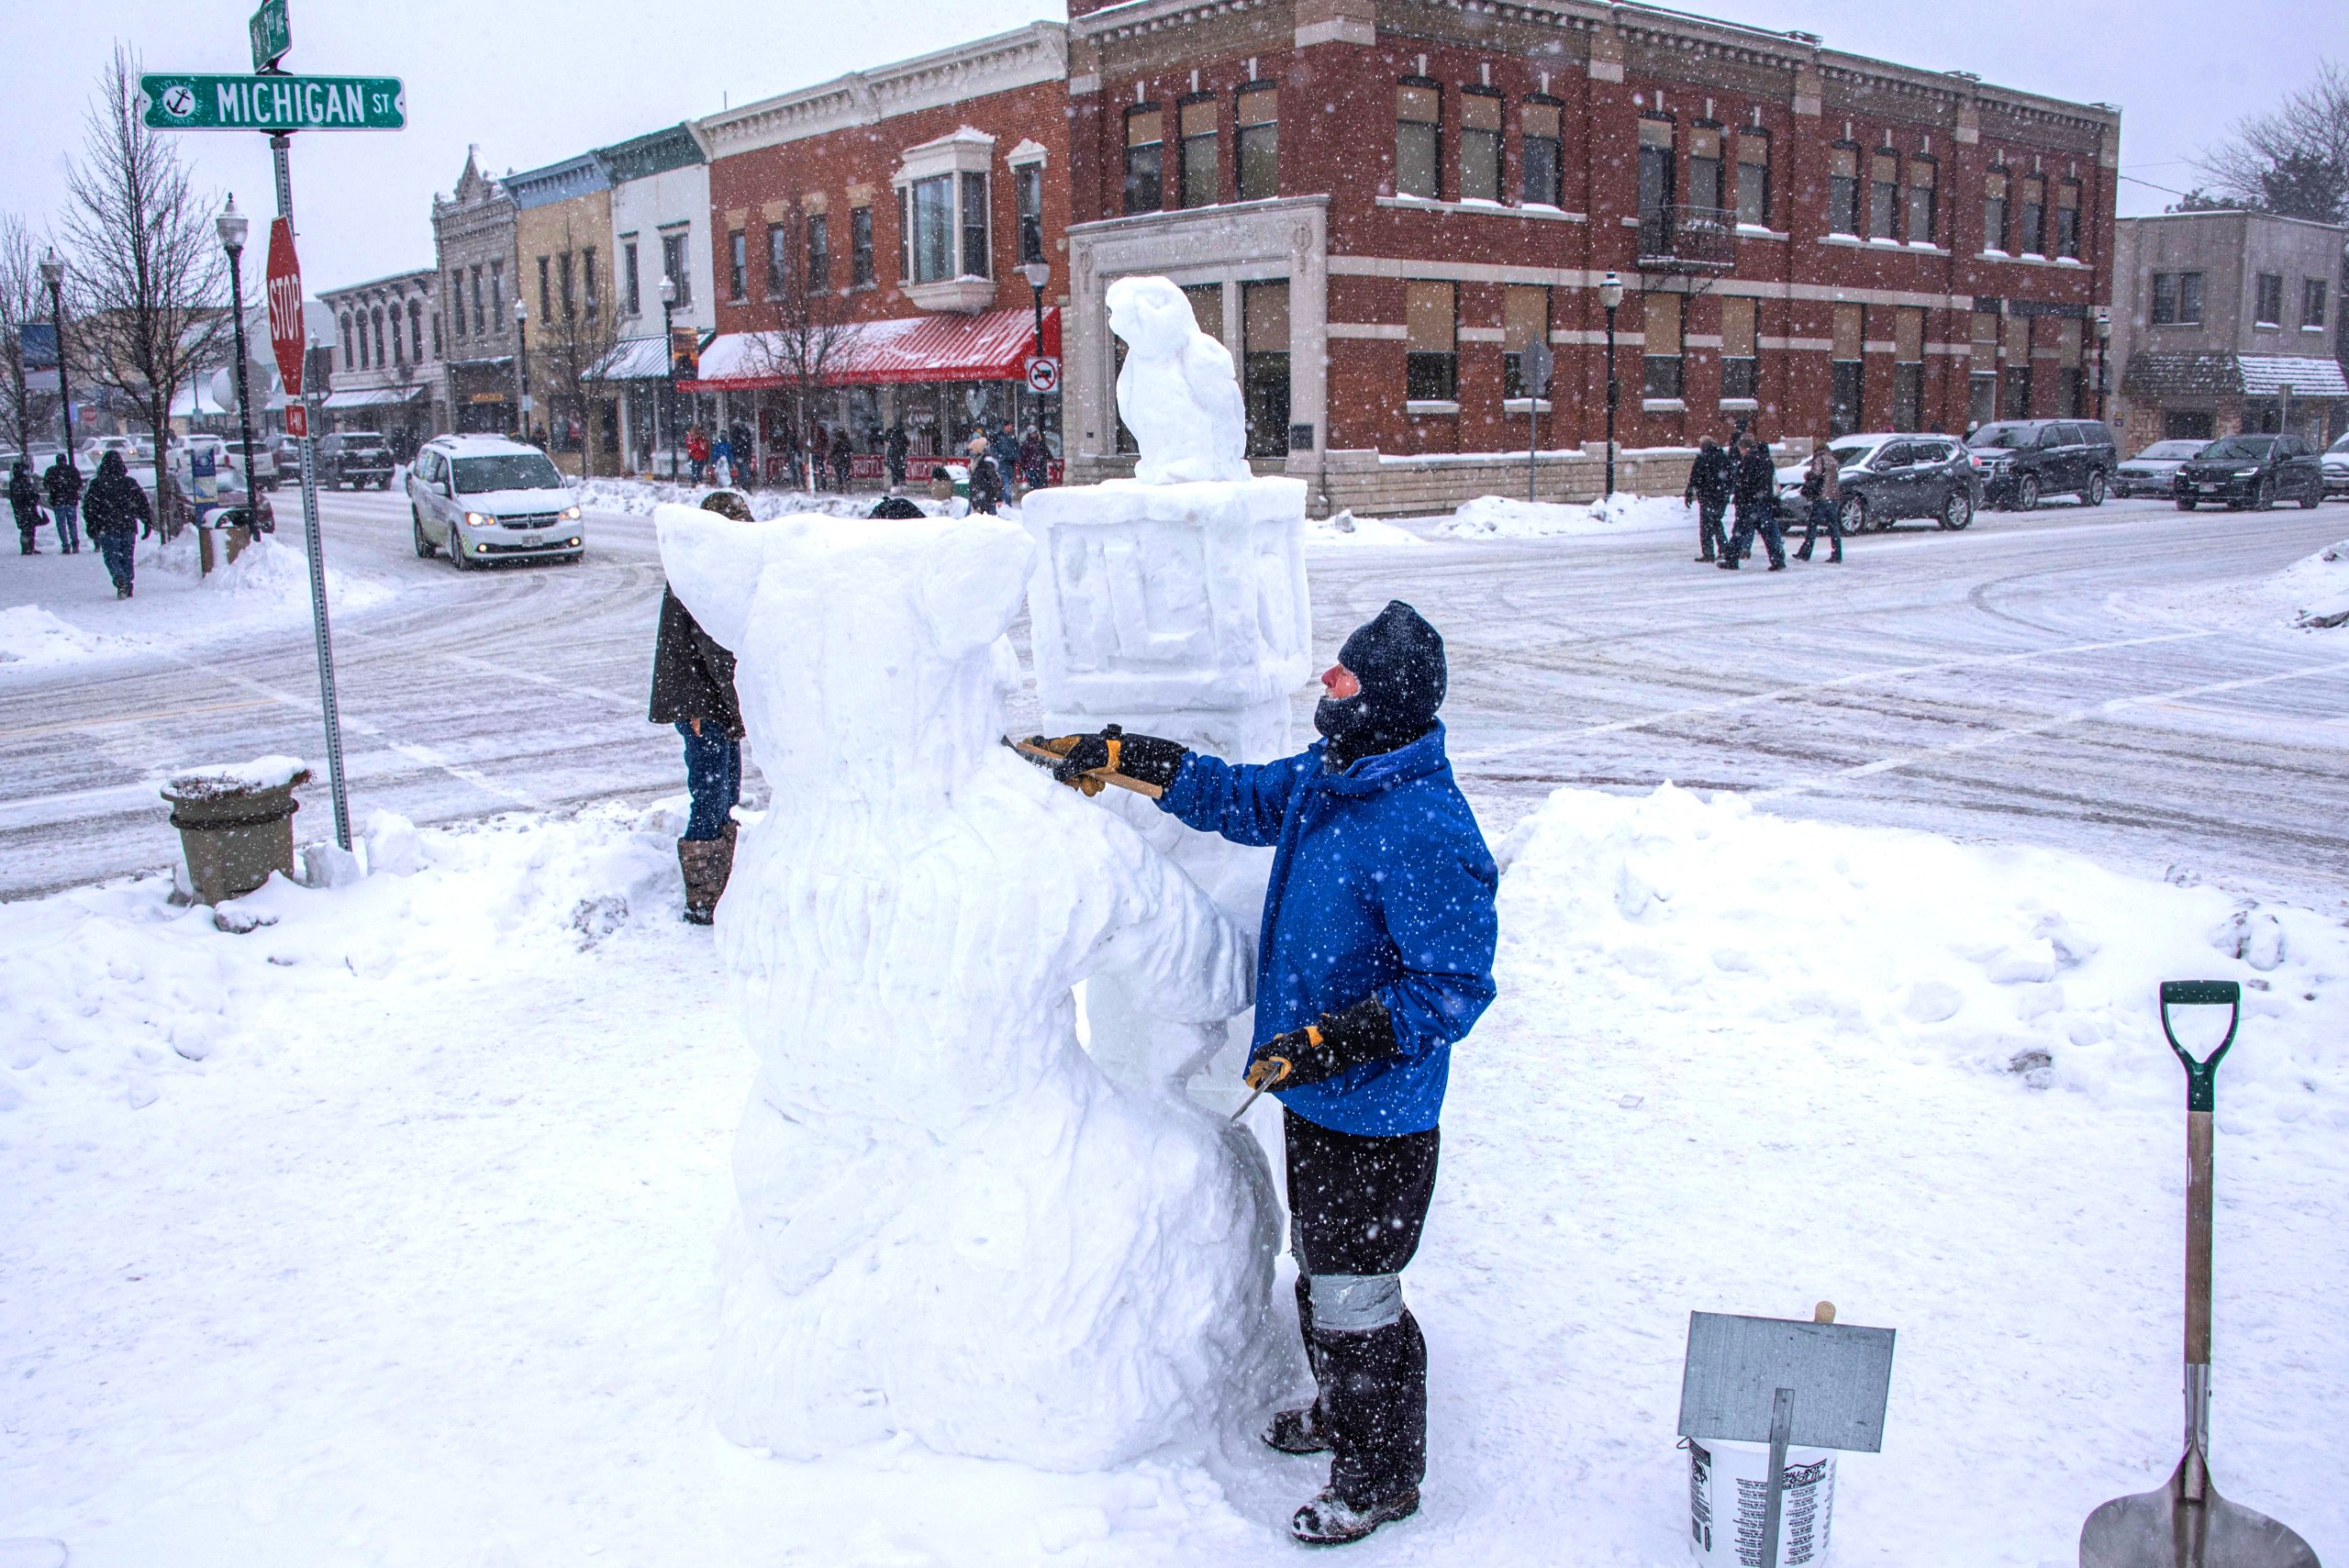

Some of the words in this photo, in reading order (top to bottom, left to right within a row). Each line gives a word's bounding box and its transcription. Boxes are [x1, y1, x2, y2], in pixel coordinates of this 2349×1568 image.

[217, 83, 365, 123] MICHIGAN
[373, 94, 389, 114] ST
[270, 273, 301, 341] STOP
[1022, 406, 1057, 416] CADY
